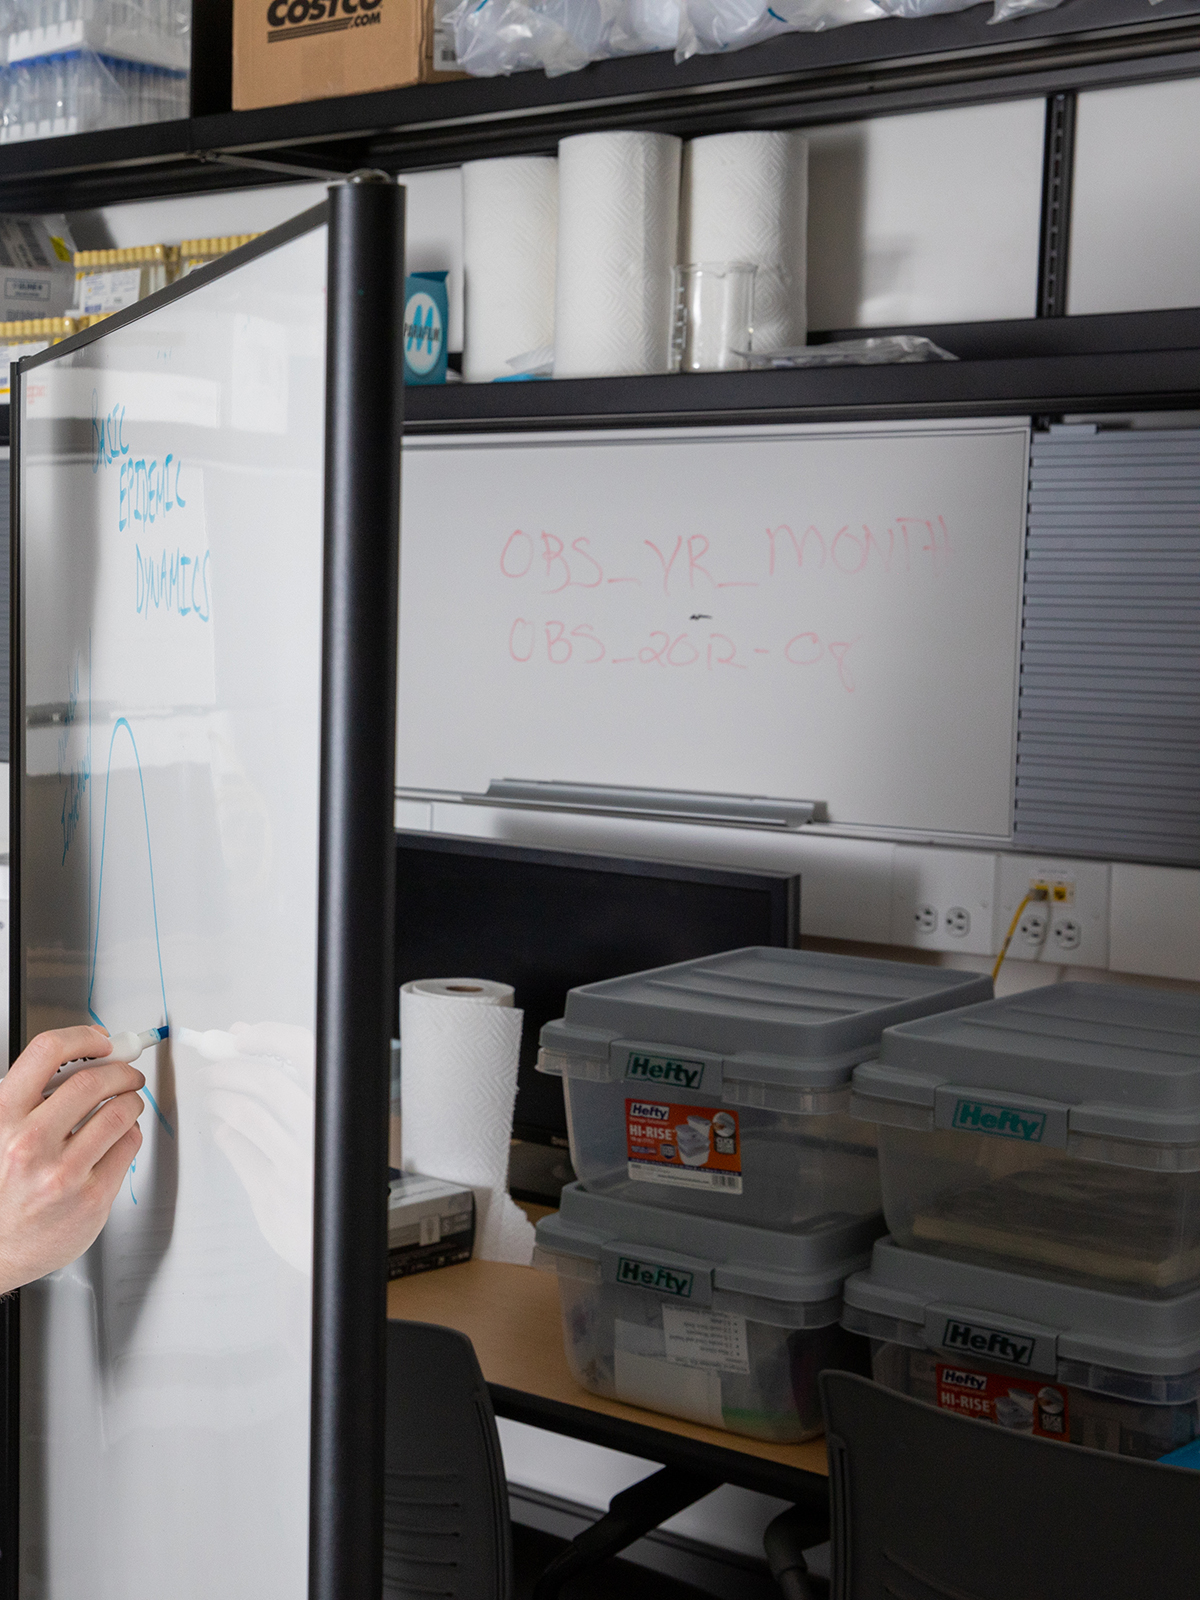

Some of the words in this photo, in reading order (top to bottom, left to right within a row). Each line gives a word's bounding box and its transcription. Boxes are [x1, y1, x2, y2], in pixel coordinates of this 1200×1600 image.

[350, 12, 381, 28] .COM
[119, 453, 186, 533] EPIDEMIC
[136, 543, 210, 622] DYNAMICS
[631, 1057, 698, 1087] Hefty
[632, 1104, 667, 1120] Hefty
[960, 1104, 1040, 1140] Hefty
[622, 1262, 688, 1295] Hefty
[950, 1324, 1029, 1362] Hefty
[944, 1370, 986, 1390] Hefty
[940, 1391, 991, 1413] HI-RISE
